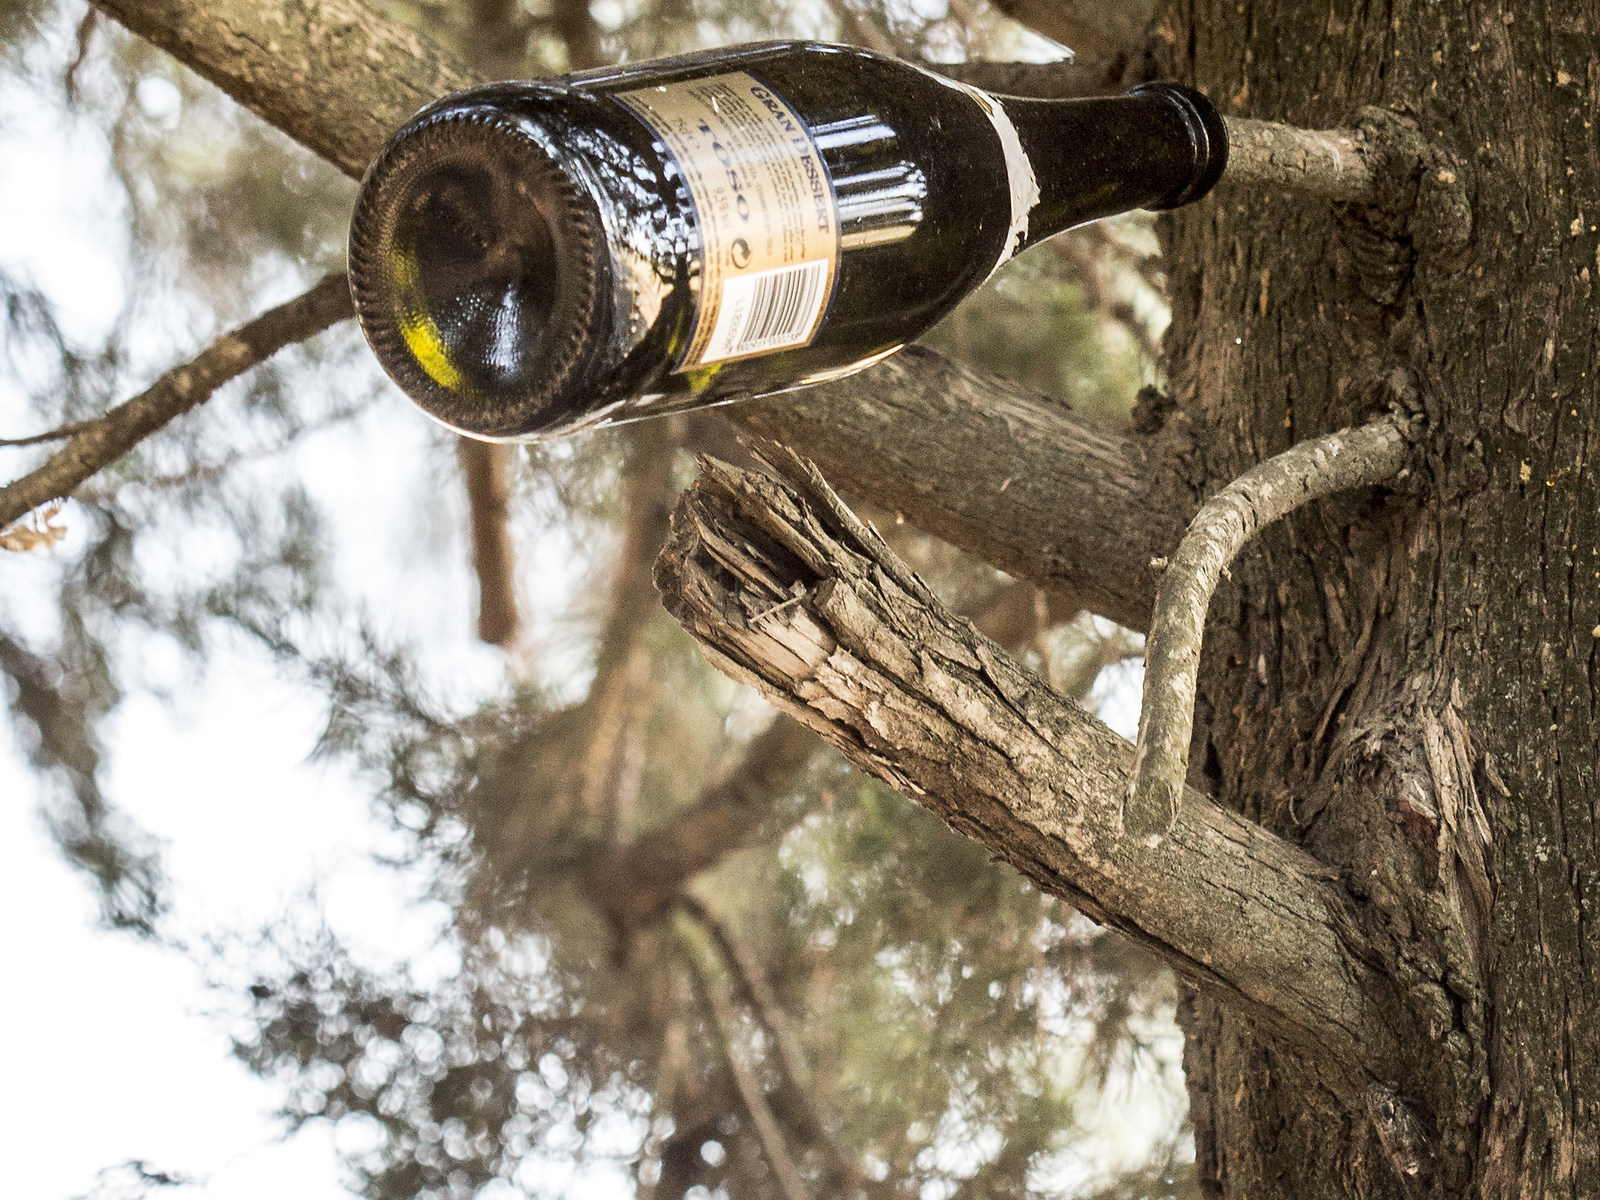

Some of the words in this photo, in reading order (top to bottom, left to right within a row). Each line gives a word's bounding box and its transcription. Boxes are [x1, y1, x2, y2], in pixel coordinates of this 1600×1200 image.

[698, 118, 749, 222] TOSO
[750, 85, 797, 133] GRAN
[792, 136, 829, 233] DESSERT
